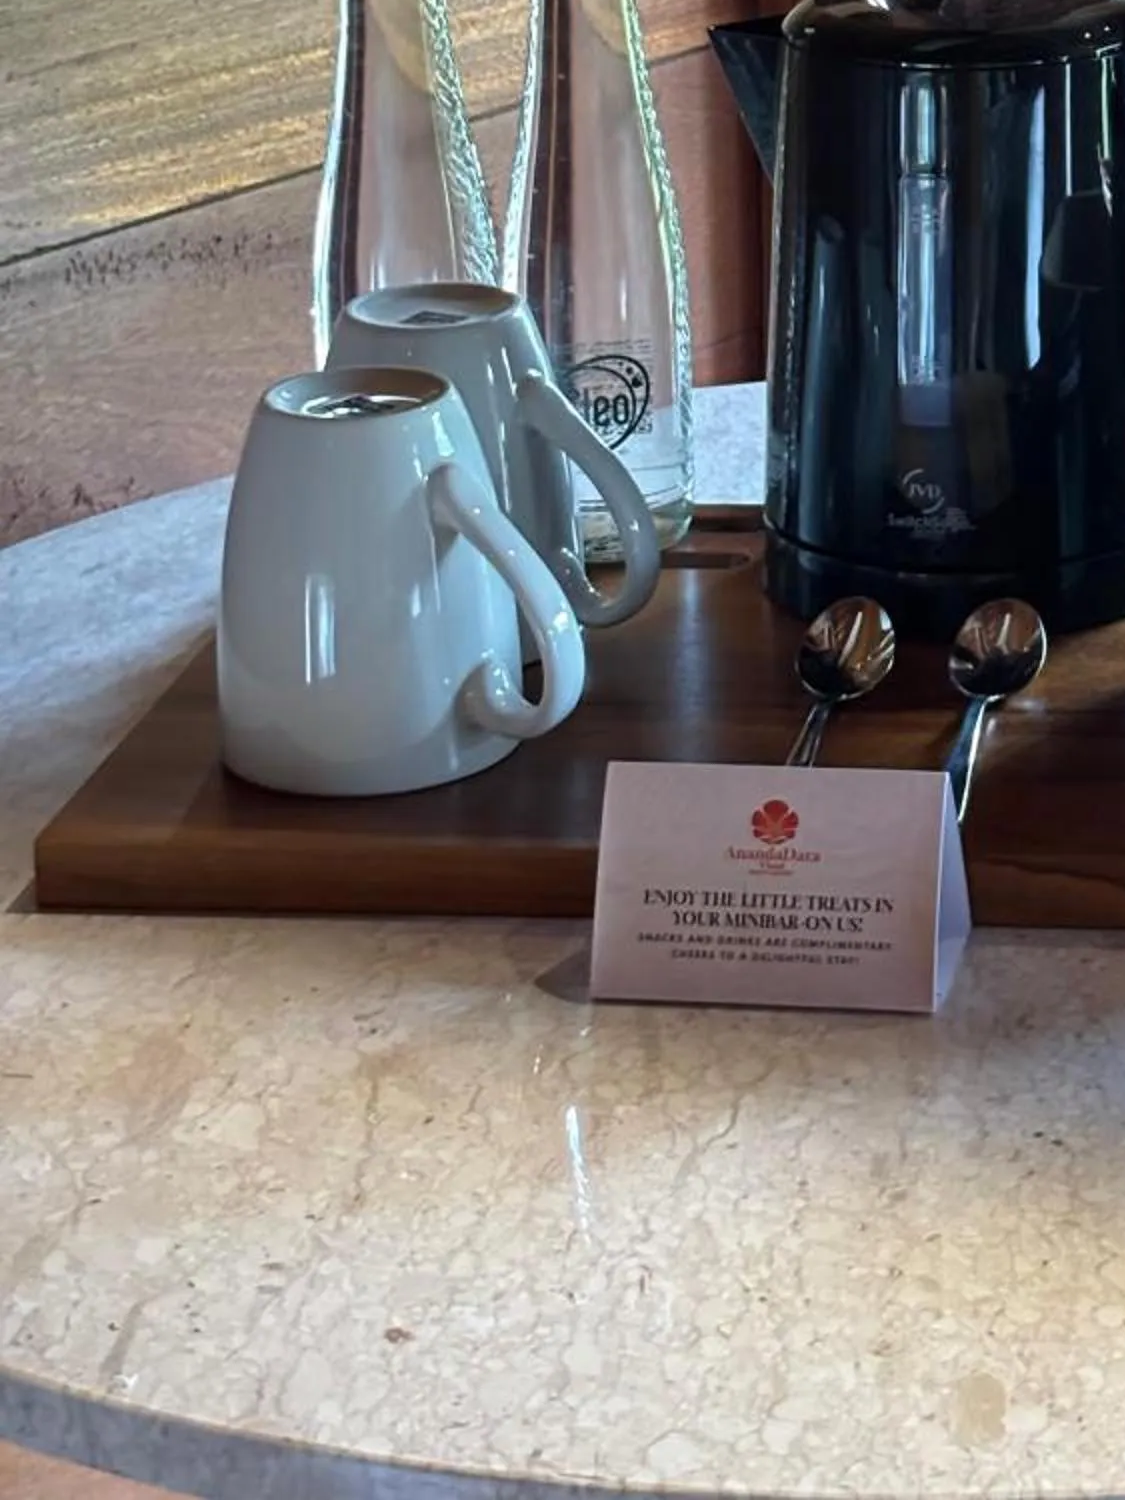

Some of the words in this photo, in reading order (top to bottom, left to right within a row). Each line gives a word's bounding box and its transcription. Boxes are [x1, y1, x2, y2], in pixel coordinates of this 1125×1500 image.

[643, 889, 696, 906] ENJOY
[702, 891, 735, 908] THE
[740, 892, 802, 910] LITTLE
[806, 895, 872, 913] TREATS
[874, 897, 895, 914] IN
[672, 910, 721, 927] YOUR
